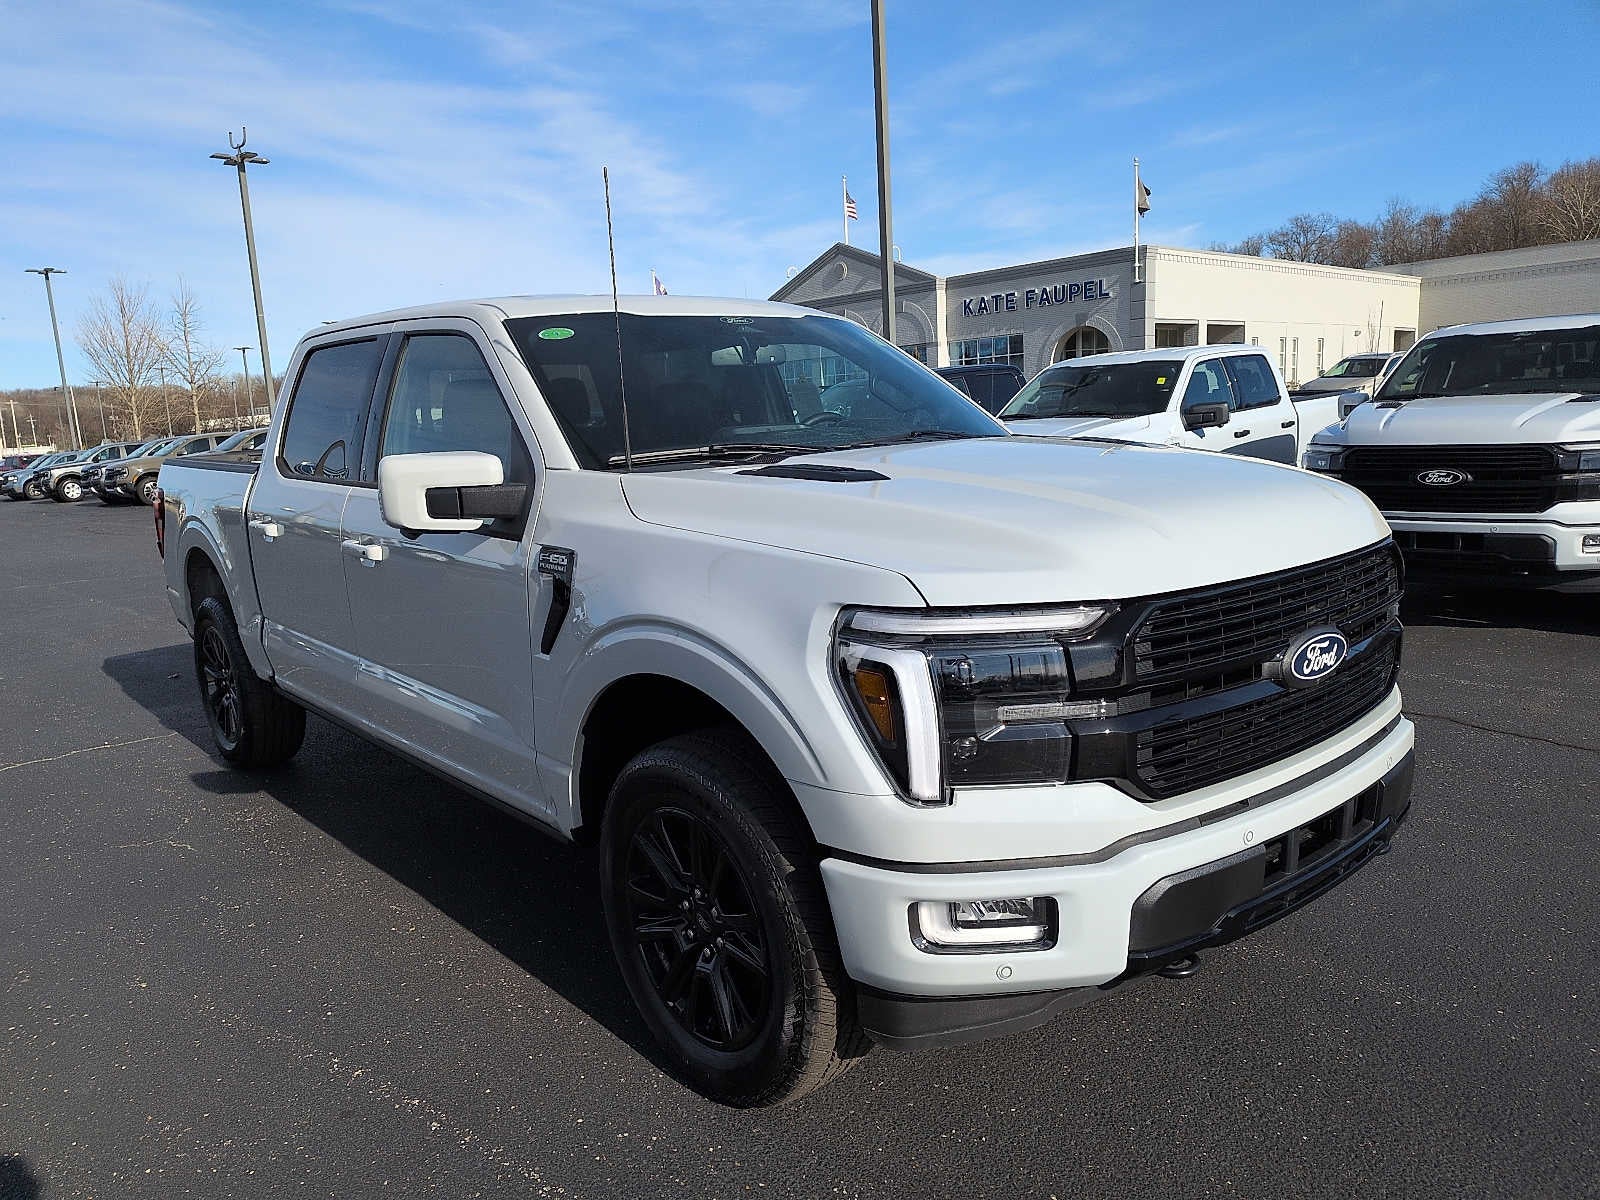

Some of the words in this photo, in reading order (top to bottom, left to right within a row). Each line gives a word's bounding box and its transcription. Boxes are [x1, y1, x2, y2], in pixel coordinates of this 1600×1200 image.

[963, 292, 1017, 317] KATE
[1025, 279, 1111, 309] FAUPEL
[1425, 472, 1454, 483] Ford
[1303, 639, 1338, 675] Ford
